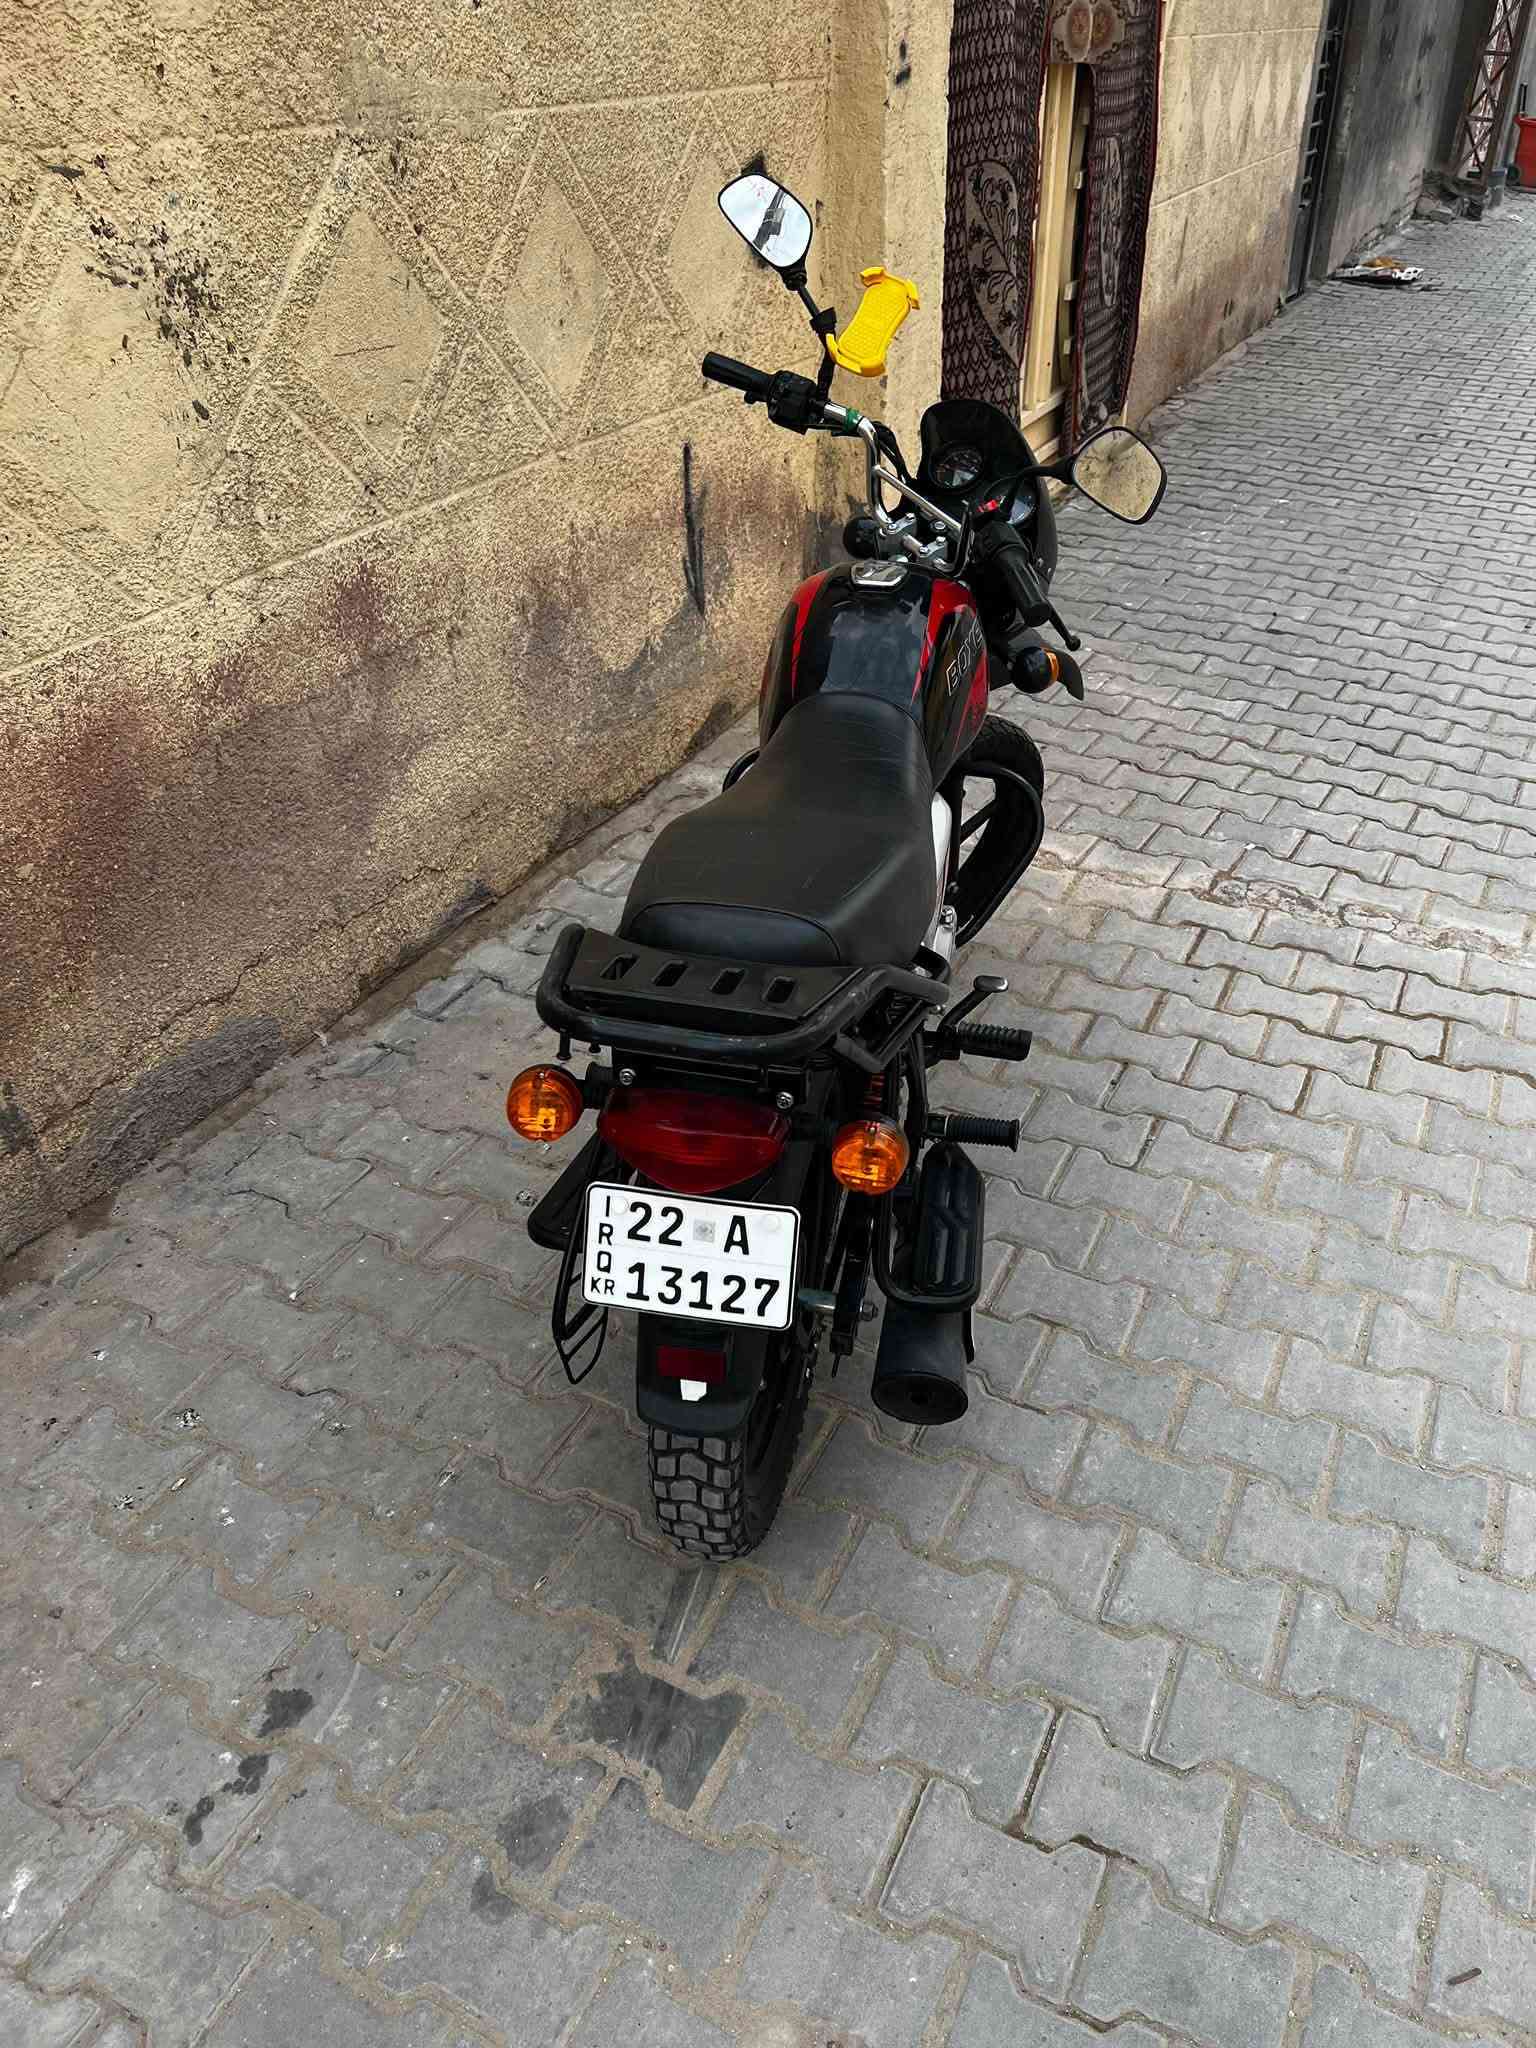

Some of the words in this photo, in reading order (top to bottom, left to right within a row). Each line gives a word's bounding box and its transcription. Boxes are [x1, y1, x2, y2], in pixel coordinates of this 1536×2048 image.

[946, 616, 984, 696] BOXE
[627, 1201, 684, 1247] 22
[723, 1214, 750, 1256] A
[590, 1276, 615, 1296] KR
[626, 1262, 780, 1317] 13127
